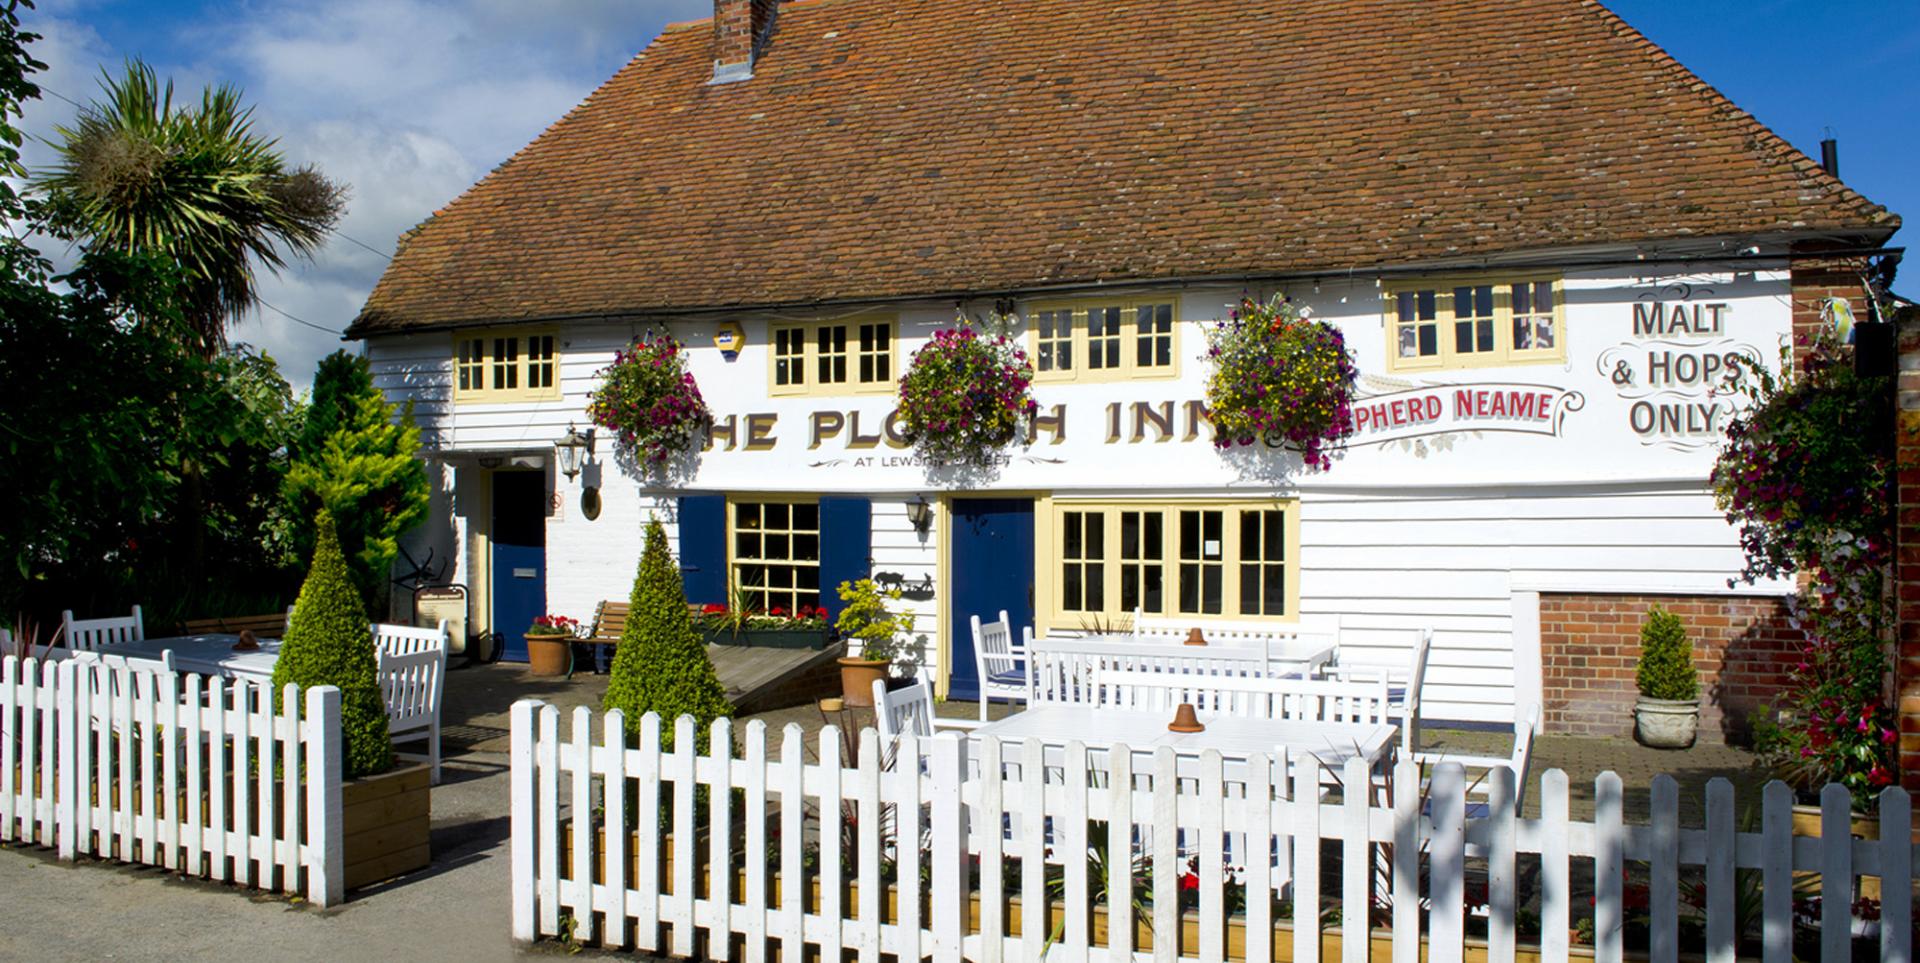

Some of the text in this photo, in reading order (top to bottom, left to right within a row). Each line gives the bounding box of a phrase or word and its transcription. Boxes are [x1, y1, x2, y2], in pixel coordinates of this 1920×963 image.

[1632, 302, 1730, 338] MALT
[1612, 351, 1743, 388] & HOPS
[701, 400, 1217, 451] HE PLH INN
[1353, 389, 1553, 436] PHERD NEAME
[854, 457, 874, 467] AT
